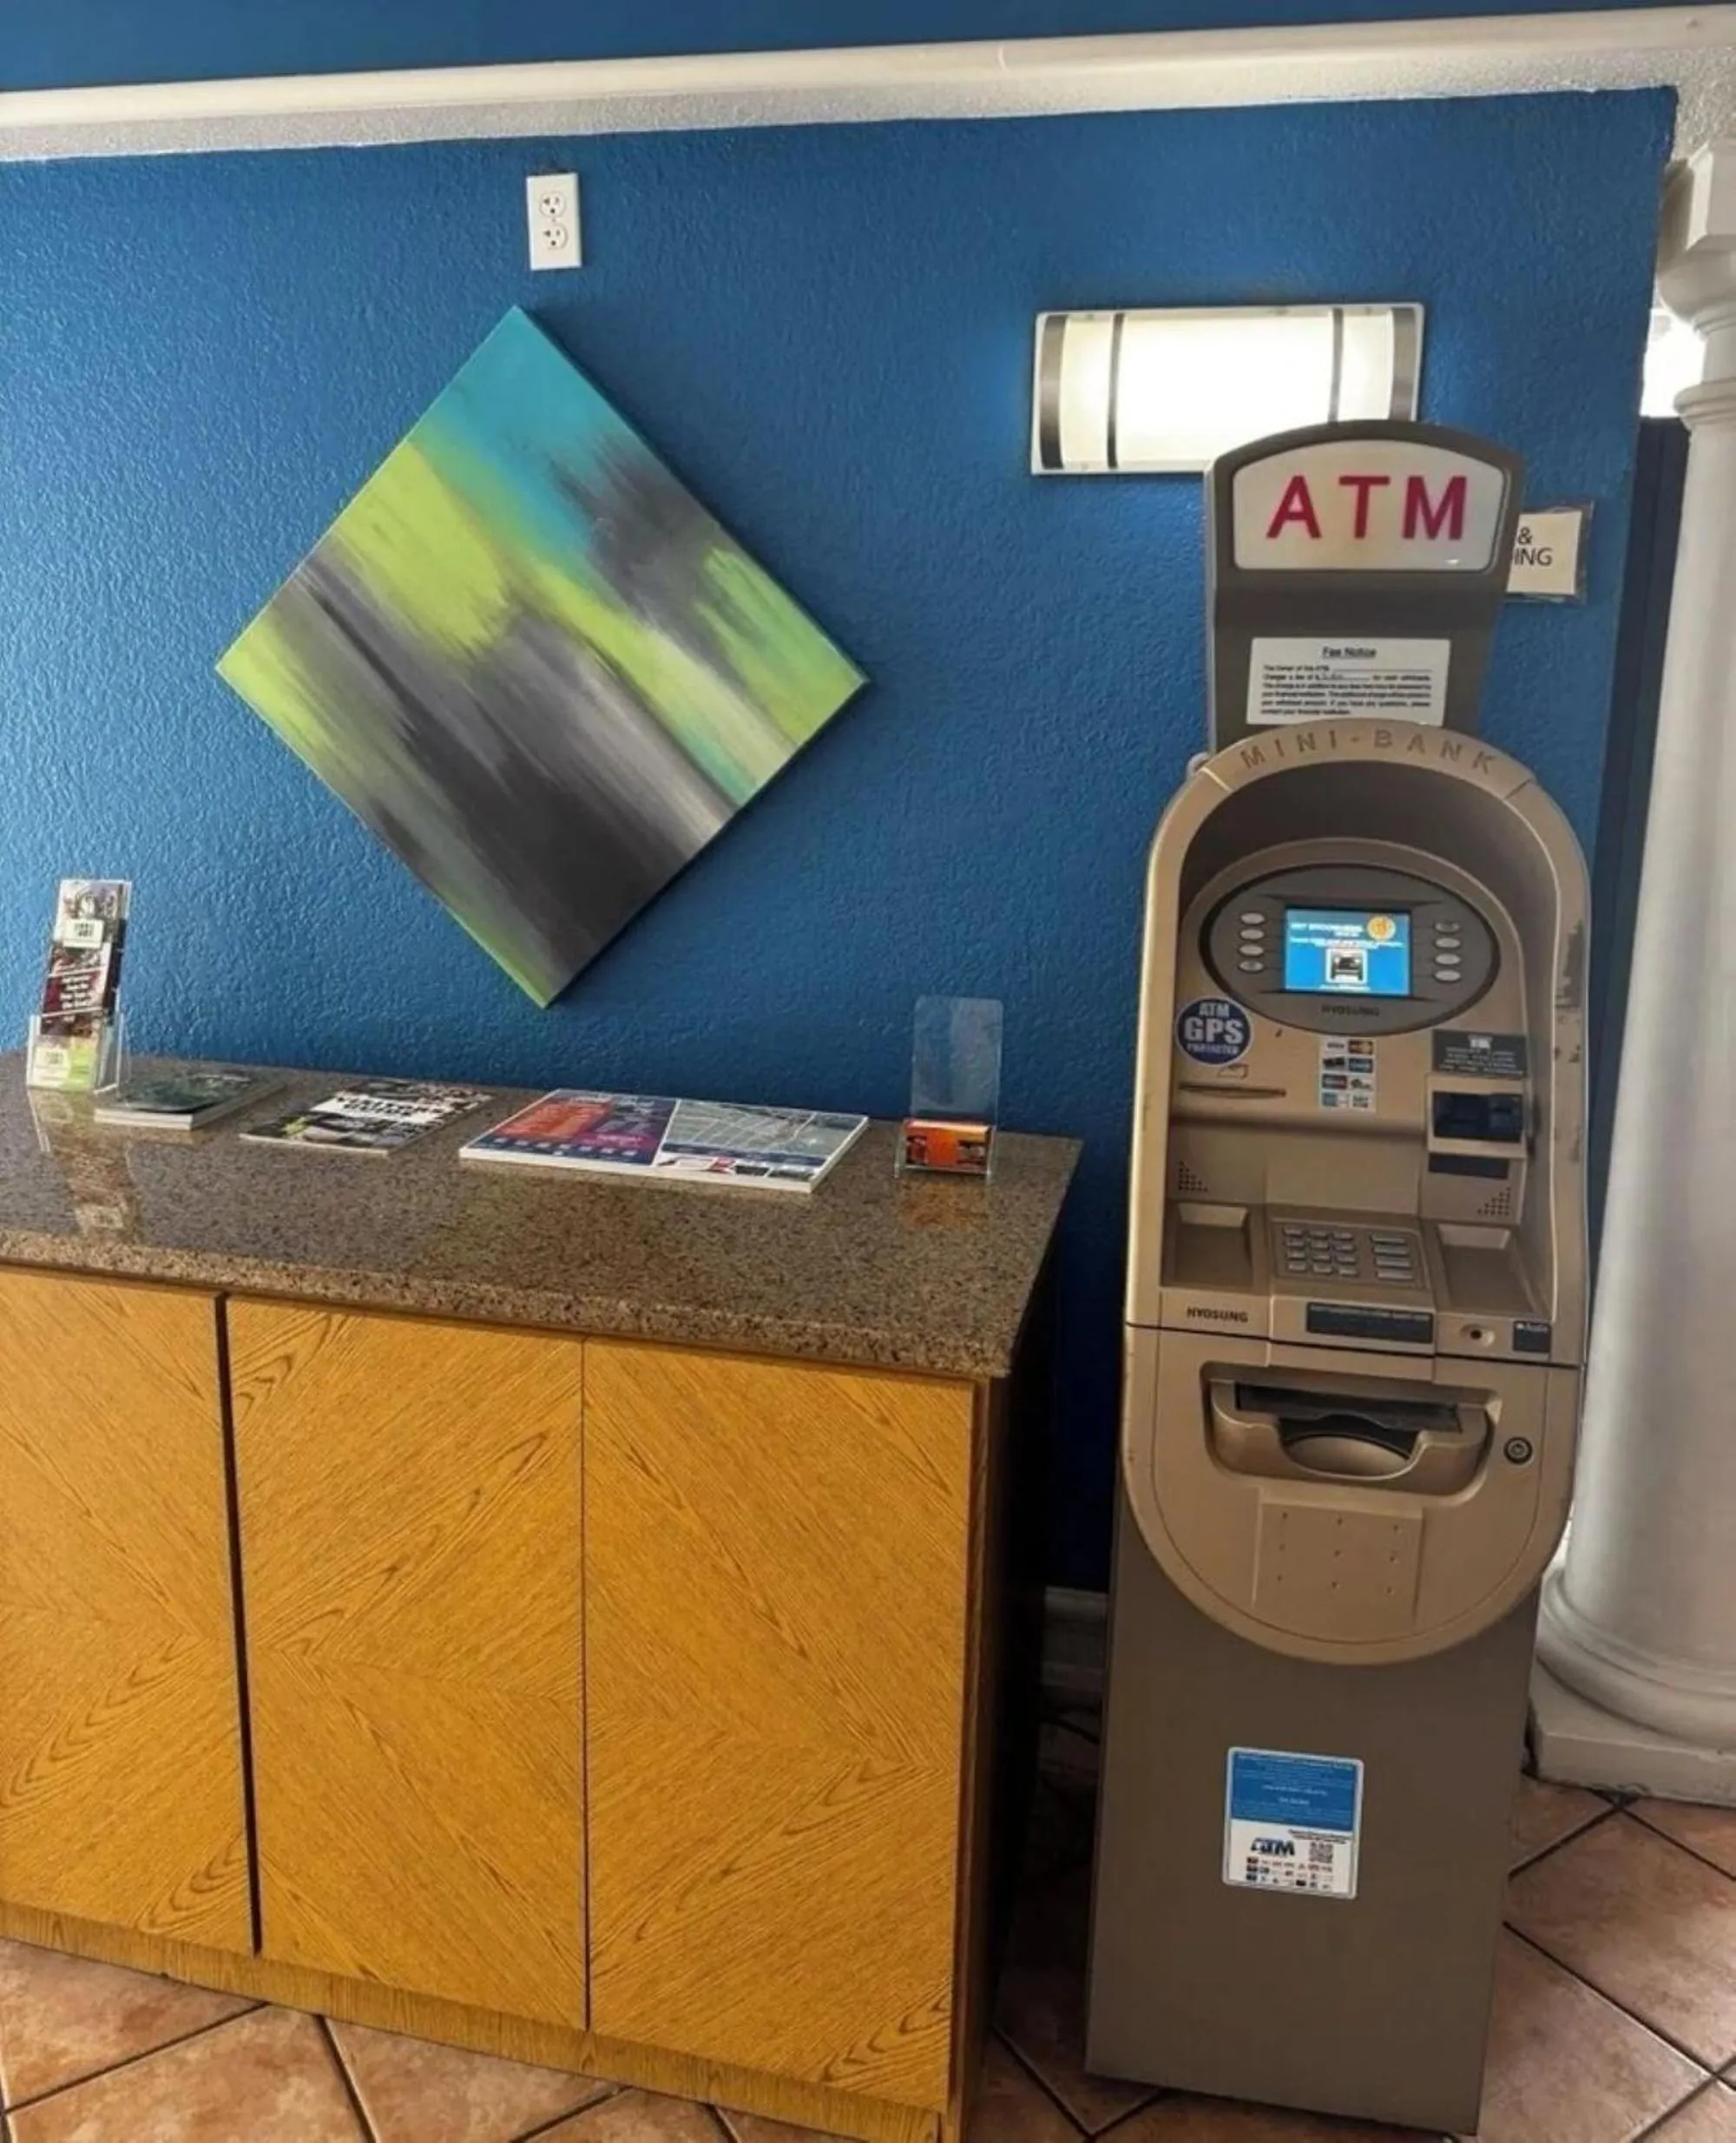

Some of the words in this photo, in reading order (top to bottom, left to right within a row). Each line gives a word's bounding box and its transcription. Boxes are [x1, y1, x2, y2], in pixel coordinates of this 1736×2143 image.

[1266, 475, 1467, 541] ATM
[1517, 526, 1533, 545] &
[1513, 547, 1554, 567] ING
[1345, 646, 1378, 658] Notice
[1240, 729, 1496, 774] MINI-BANK
[1199, 1002, 1230, 1017] ATM
[1184, 1016, 1245, 1044] GPS
